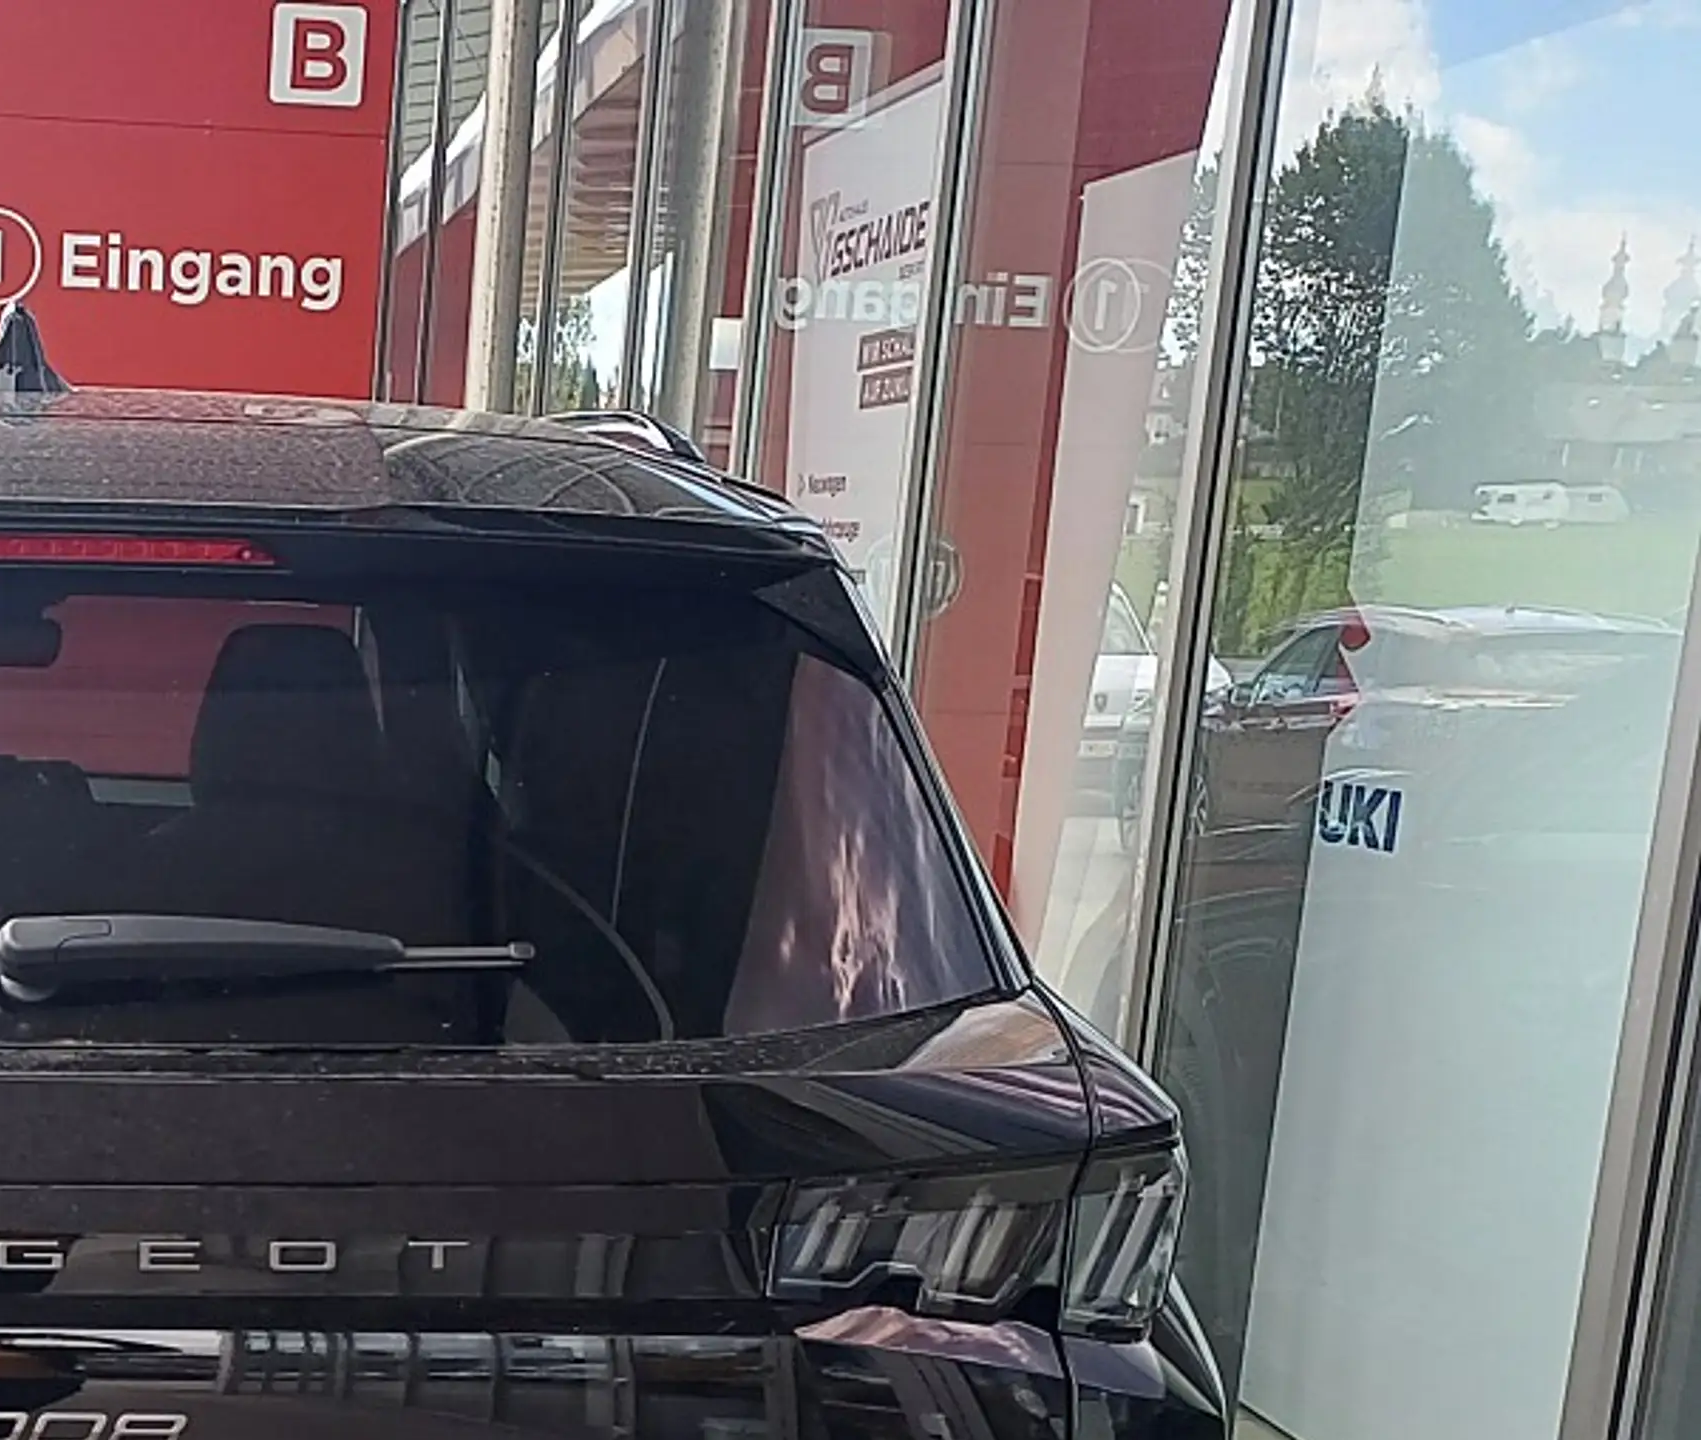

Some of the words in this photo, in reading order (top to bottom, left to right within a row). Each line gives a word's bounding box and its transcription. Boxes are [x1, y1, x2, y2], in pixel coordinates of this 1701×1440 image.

[289, 16, 349, 91] B
[61, 231, 343, 312] Eingang
[1320, 780, 1402, 853] UKI
